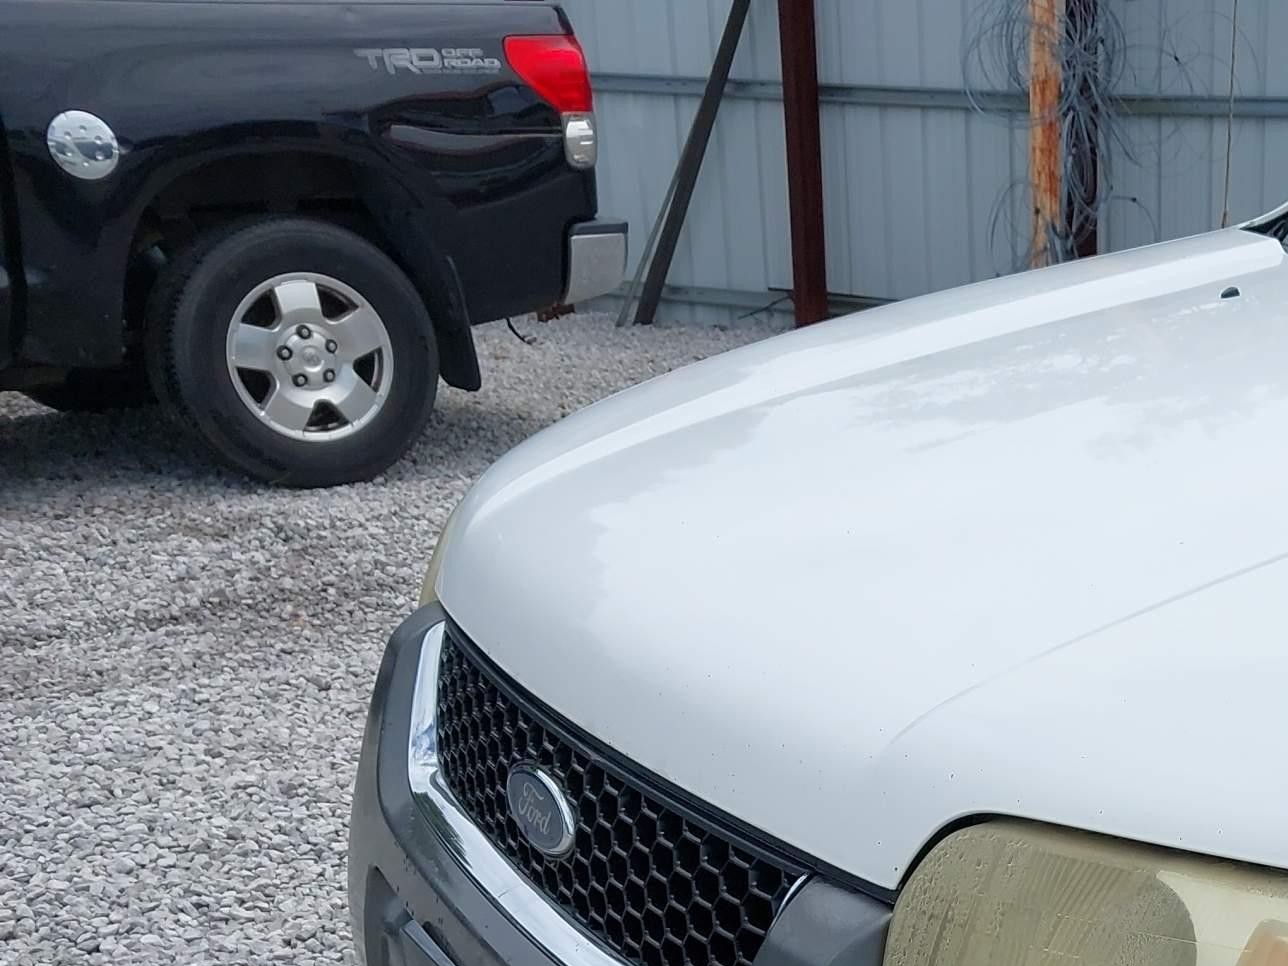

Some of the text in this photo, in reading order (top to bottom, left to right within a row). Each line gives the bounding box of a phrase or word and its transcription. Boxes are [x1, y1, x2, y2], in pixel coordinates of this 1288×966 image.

[353, 48, 442, 75] TRD
[441, 48, 484, 57] OFF
[443, 58, 502, 69] ROAD
[518, 782, 552, 835] Ford
